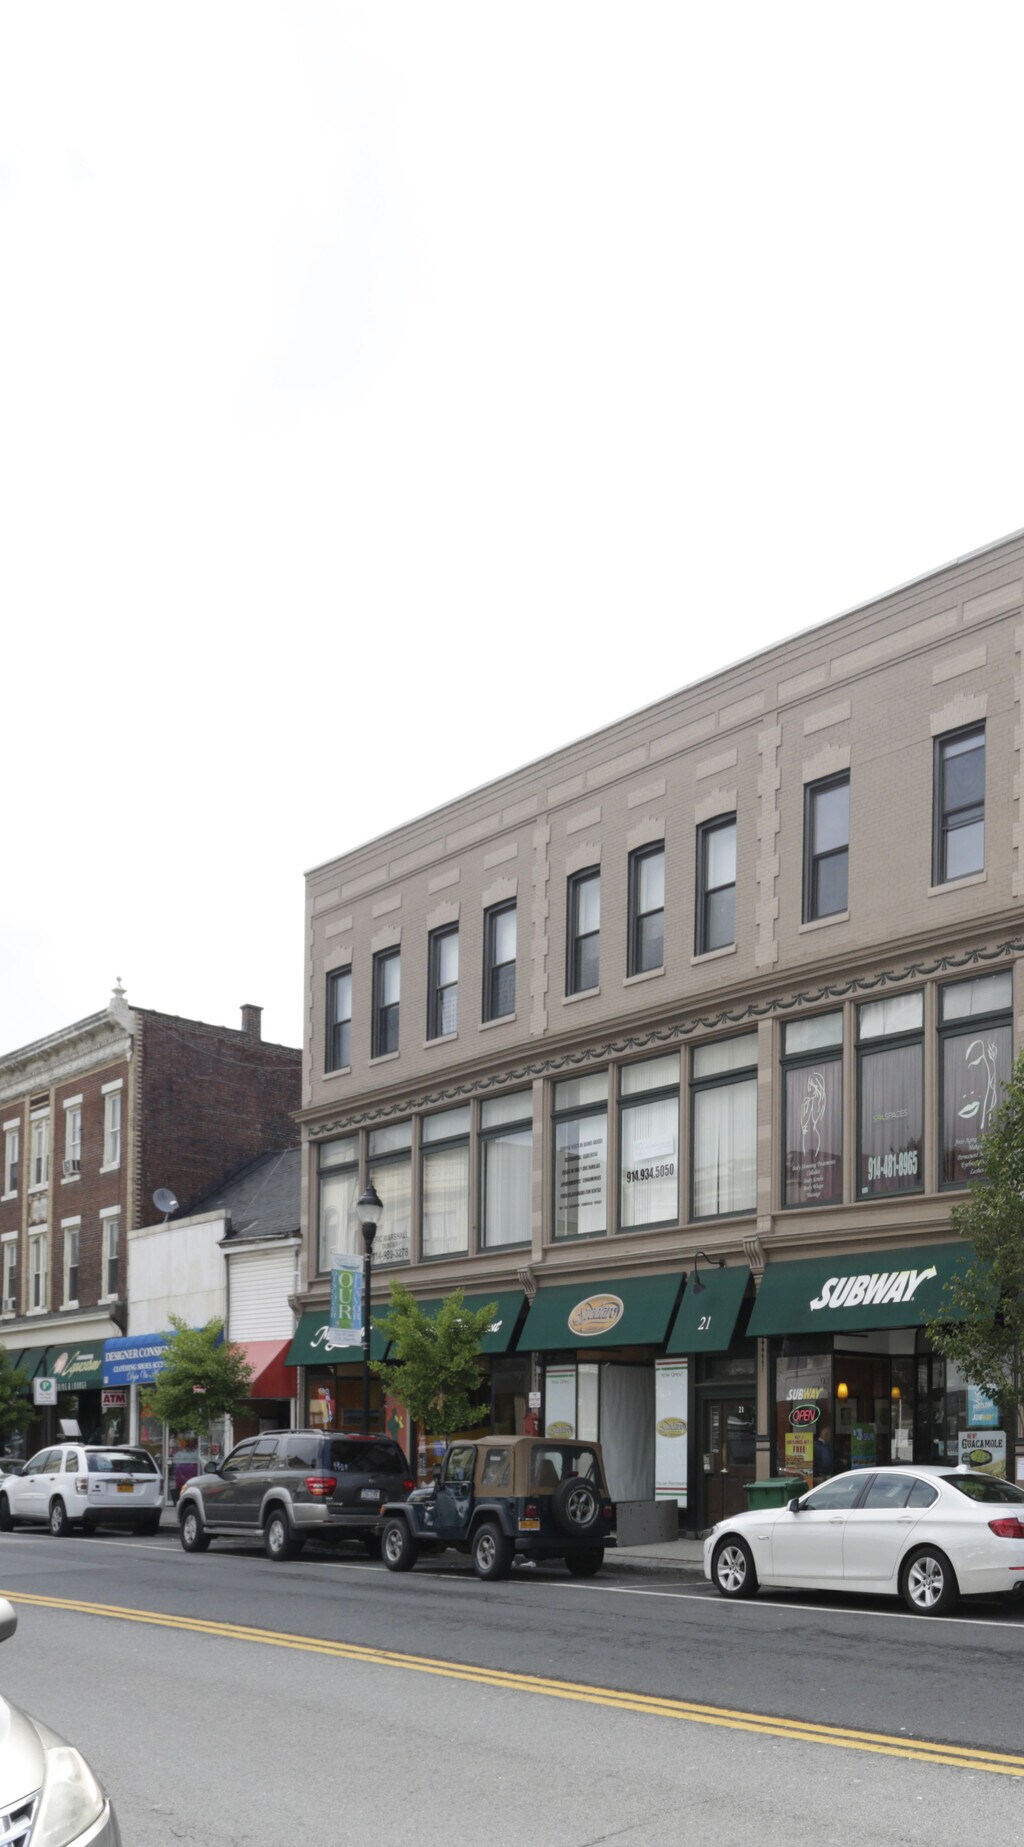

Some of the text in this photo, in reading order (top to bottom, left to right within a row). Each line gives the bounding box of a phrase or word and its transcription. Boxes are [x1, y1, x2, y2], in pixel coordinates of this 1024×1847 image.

[626, 1163, 675, 1183] 914.934.5050
[868, 1150, 918, 1181] 914-481-8965
[810, 1264, 938, 1311] SUBWAY
[338, 1272, 354, 1320] OUR
[697, 1316, 711, 1331] 21
[105, 1345, 169, 1362] DESIGNER CONSIG
[103, 1394, 126, 1404] ATM
[786, 1387, 824, 1400] SUBWAY
[792, 1409, 816, 1422] OPEN
[793, 1446, 806, 1454] FREE
[961, 1439, 1003, 1449] GUACAMOLE
